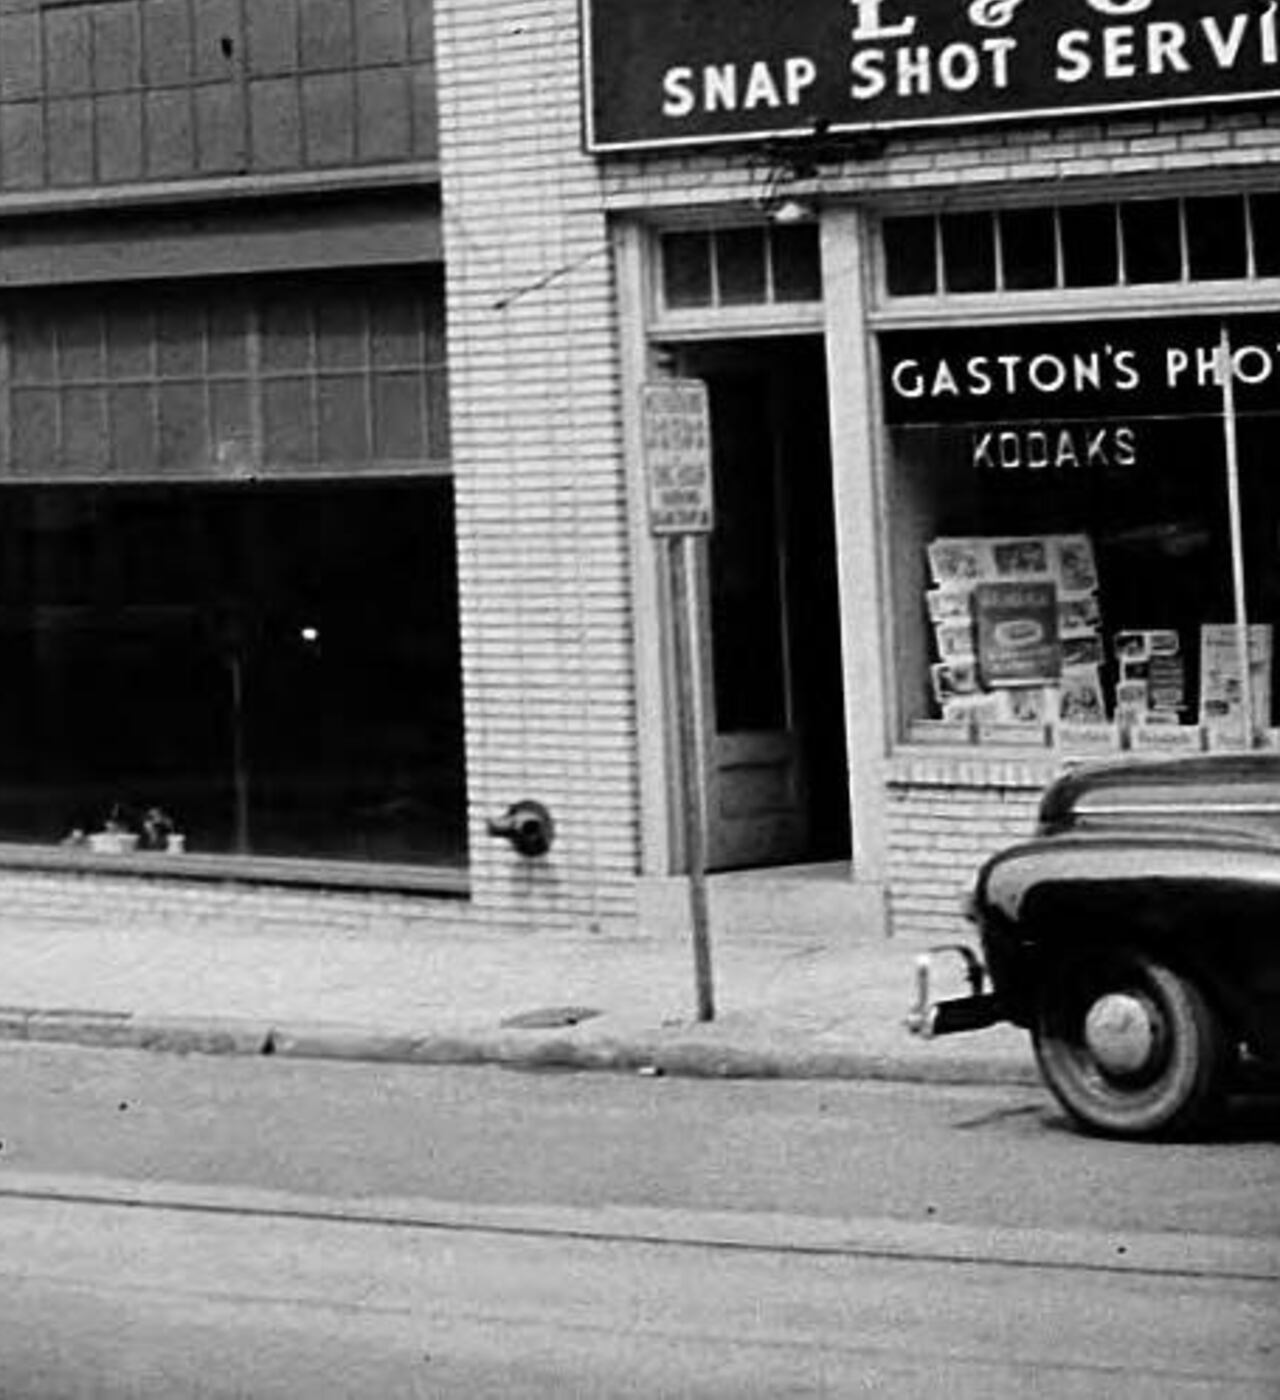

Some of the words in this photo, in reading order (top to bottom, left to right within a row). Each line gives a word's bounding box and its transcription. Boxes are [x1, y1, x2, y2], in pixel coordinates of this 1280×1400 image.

[661, 56, 817, 118] SNAP
[850, 37, 1018, 99] SHOT
[1055, 1, 1280, 83] SERVI
[890, 344, 1140, 399] GASTON'S
[1165, 343, 1280, 388] PHO
[972, 426, 1137, 469] KODAKS
